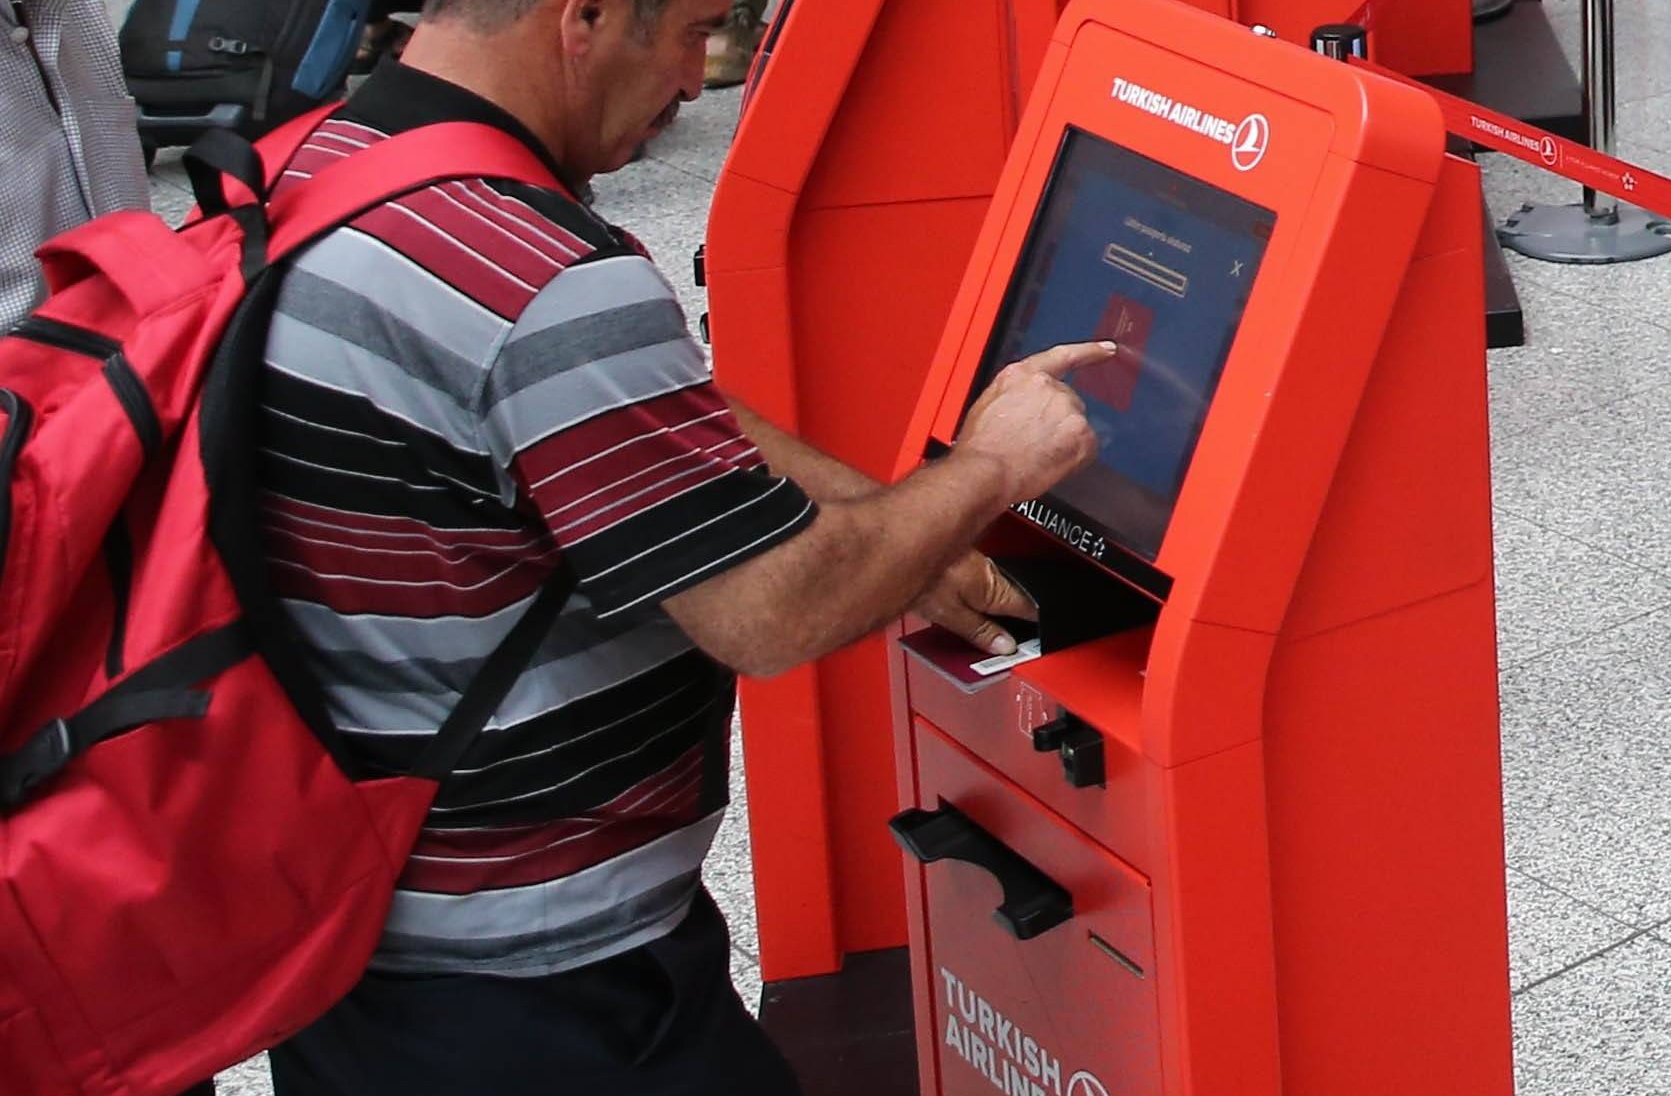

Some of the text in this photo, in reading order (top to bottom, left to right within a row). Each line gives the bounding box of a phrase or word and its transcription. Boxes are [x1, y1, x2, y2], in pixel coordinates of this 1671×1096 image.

[1111, 77, 1237, 146] TURKISH AIRLINES
[1471, 115, 1540, 152] TURKISH AIRLINES
[1016, 499, 1093, 552] ALLIANCE
[940, 966, 1062, 1096] TURKISH
